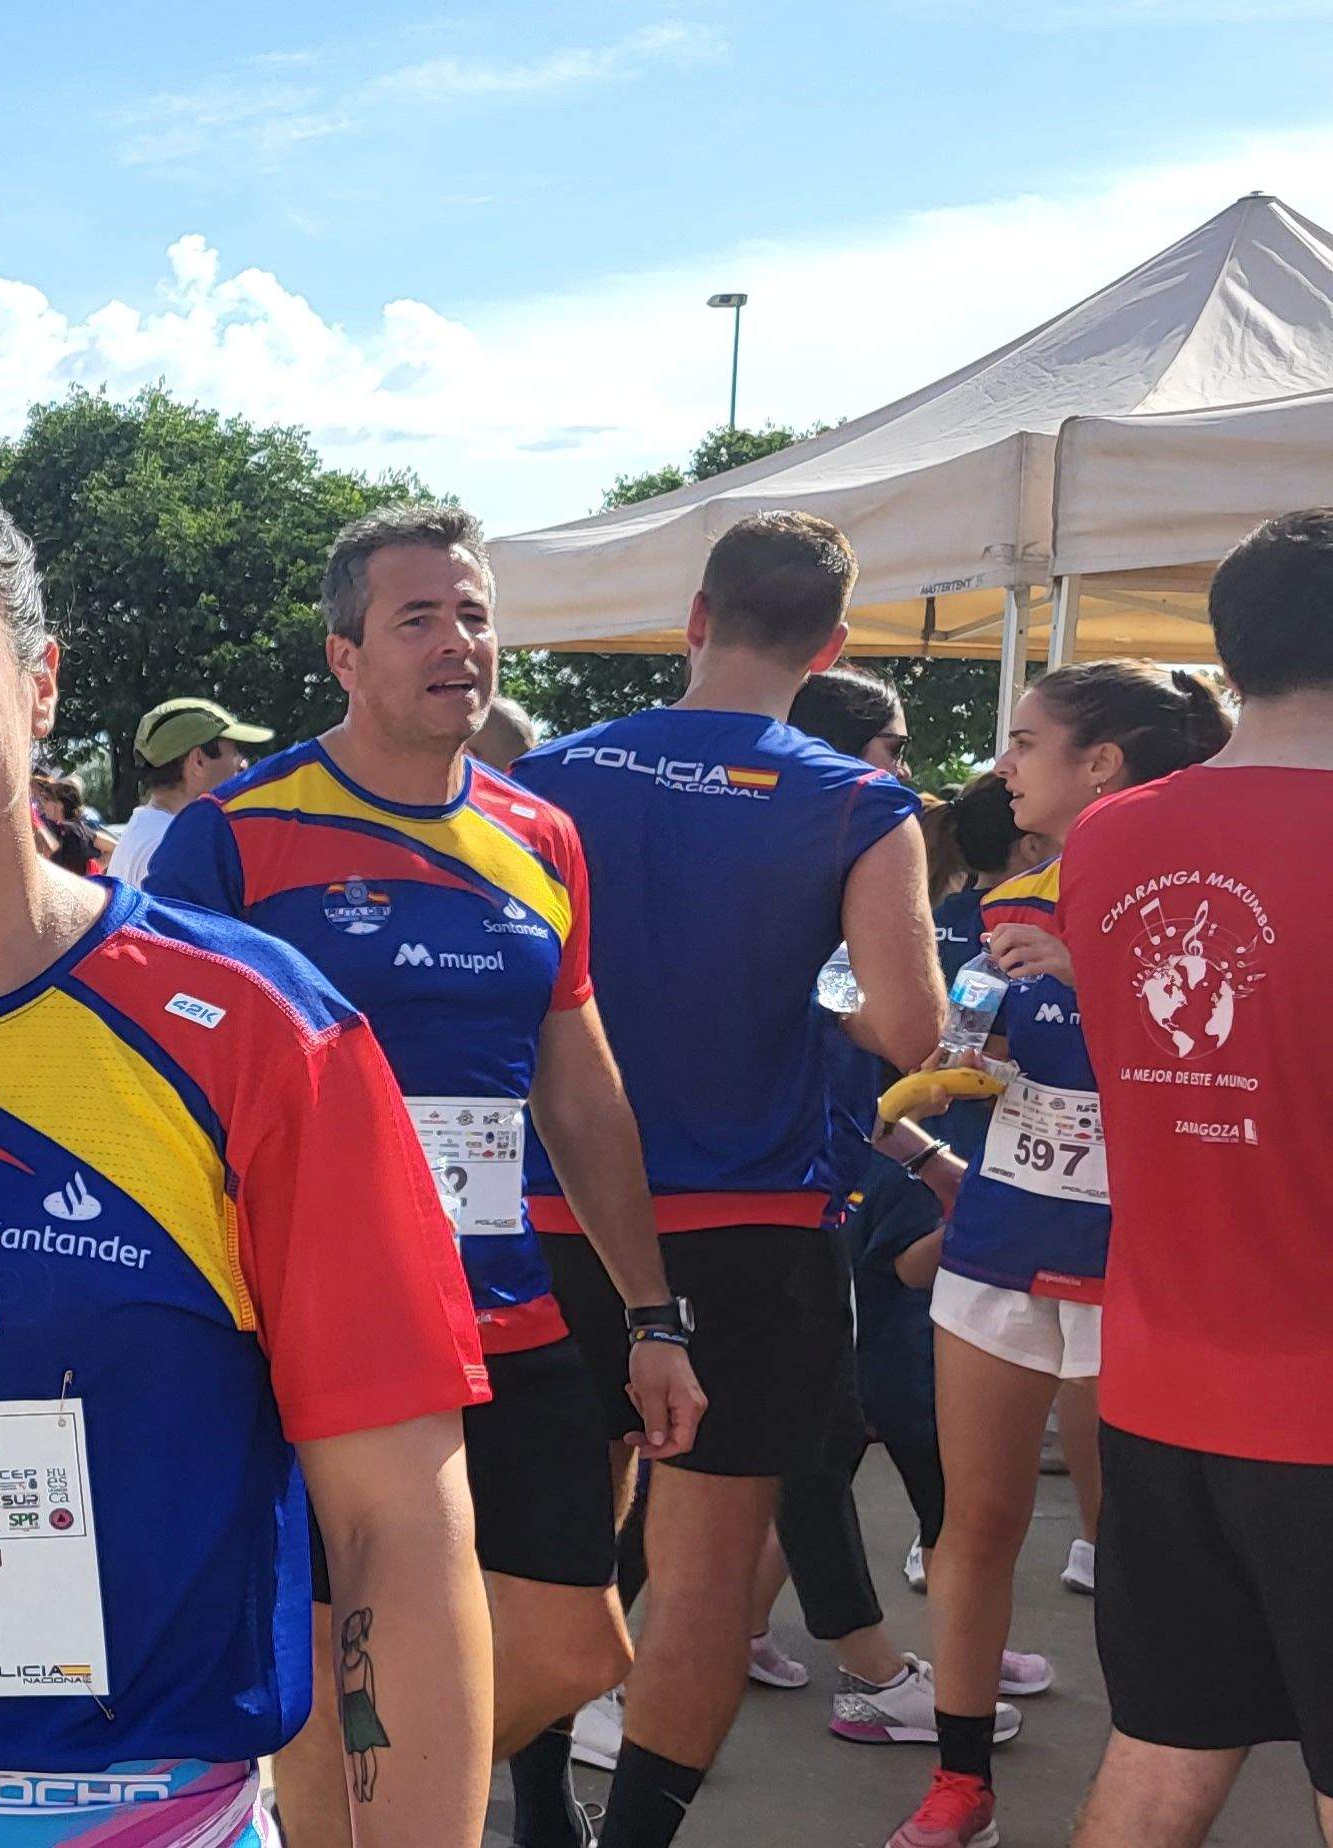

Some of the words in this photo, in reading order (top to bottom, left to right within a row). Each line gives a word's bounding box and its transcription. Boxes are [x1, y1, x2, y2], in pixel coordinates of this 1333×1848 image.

[655, 778, 770, 800] NACIONAL
[1101, 870, 1201, 934] CHARANGA
[1205, 871, 1276, 945] MAKUMBO
[483, 918, 549, 940] Santander
[439, 950, 505, 974] mupol
[172, 1000, 219, 1023] 42K
[1121, 1067, 1131, 1080] LA
[1133, 1068, 1172, 1083] MEJOR
[1175, 1071, 1189, 1084] DE
[1190, 1072, 1212, 1086] ESTE
[1215, 1073, 1259, 1091] MUNDO
[1175, 1120, 1239, 1137] ZARAGOZA
[1014, 1132, 1091, 1177] 597
[0, 1495, 39, 1506] SUR
[8, 1512, 39, 1526] SPP
[22, 1676, 91, 1685] NACIONAL
